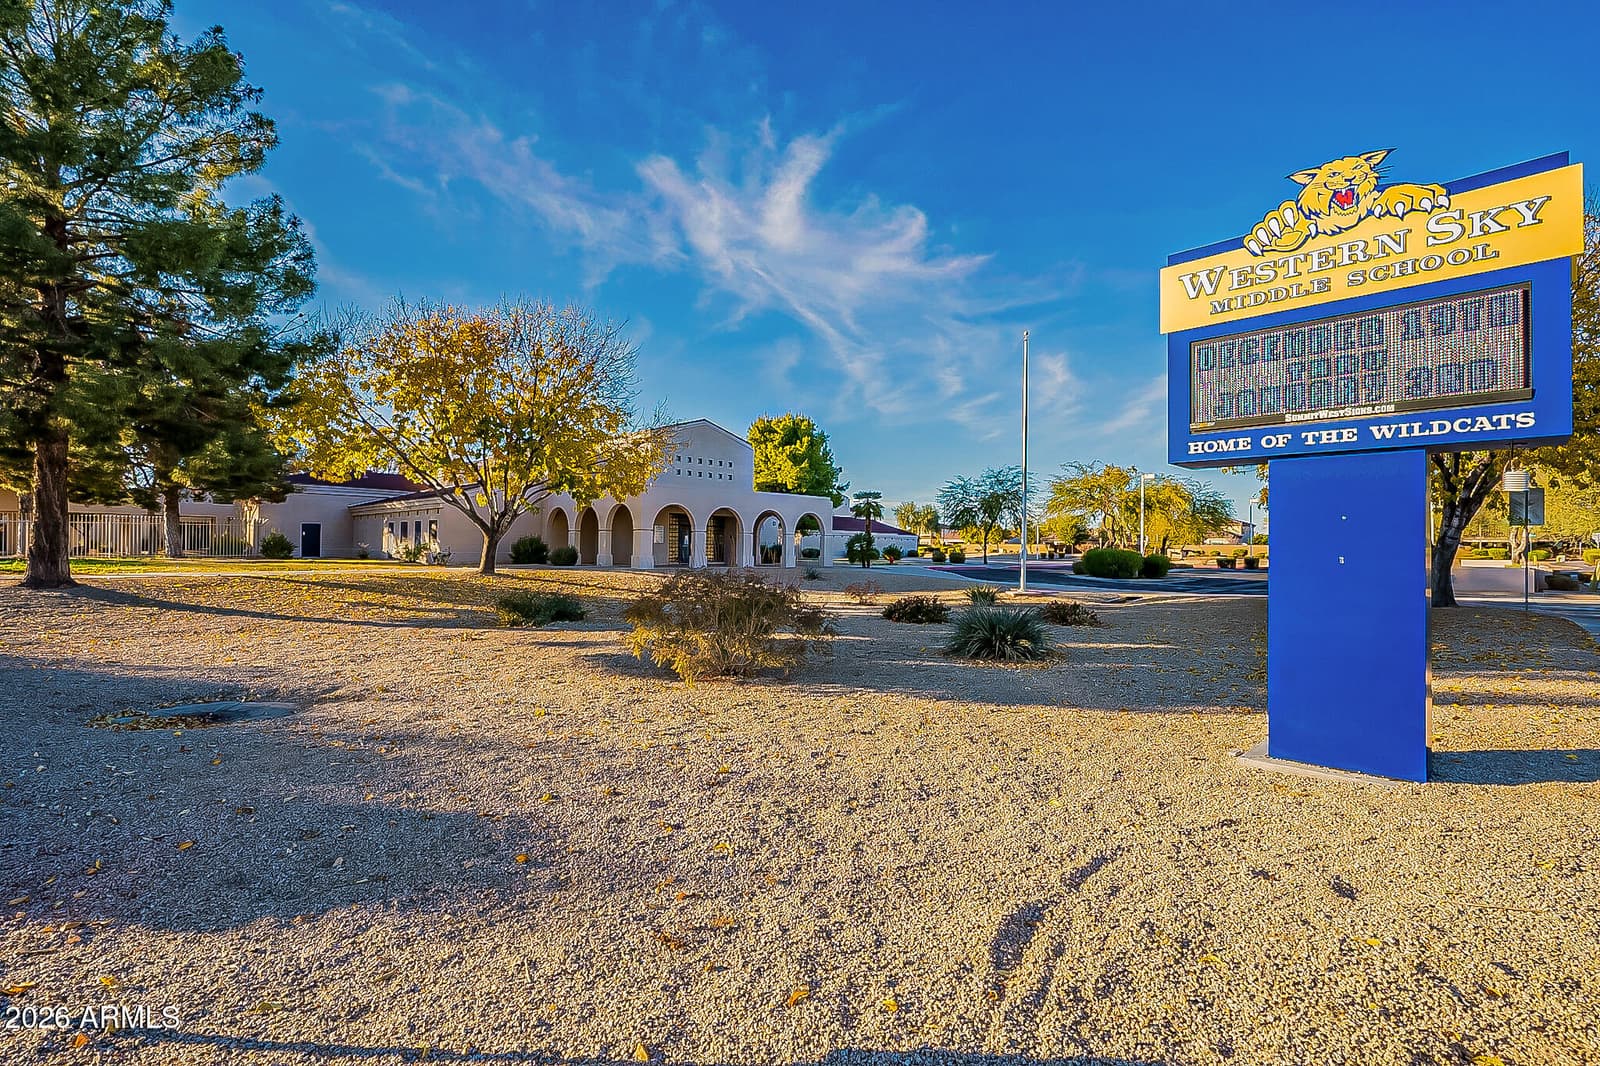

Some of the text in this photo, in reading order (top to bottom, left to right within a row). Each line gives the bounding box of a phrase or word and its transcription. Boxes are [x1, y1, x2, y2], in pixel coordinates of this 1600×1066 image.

[1209, 243, 1499, 315] MIDDLE SCHOOL
[1196, 290, 1520, 372] DECEMBER 19TH
[1213, 356, 1498, 419] JANUARY 3RD
[1285, 347, 1388, 383] THRU
[1188, 411, 1536, 454] HOME OF THE WILDCATS
